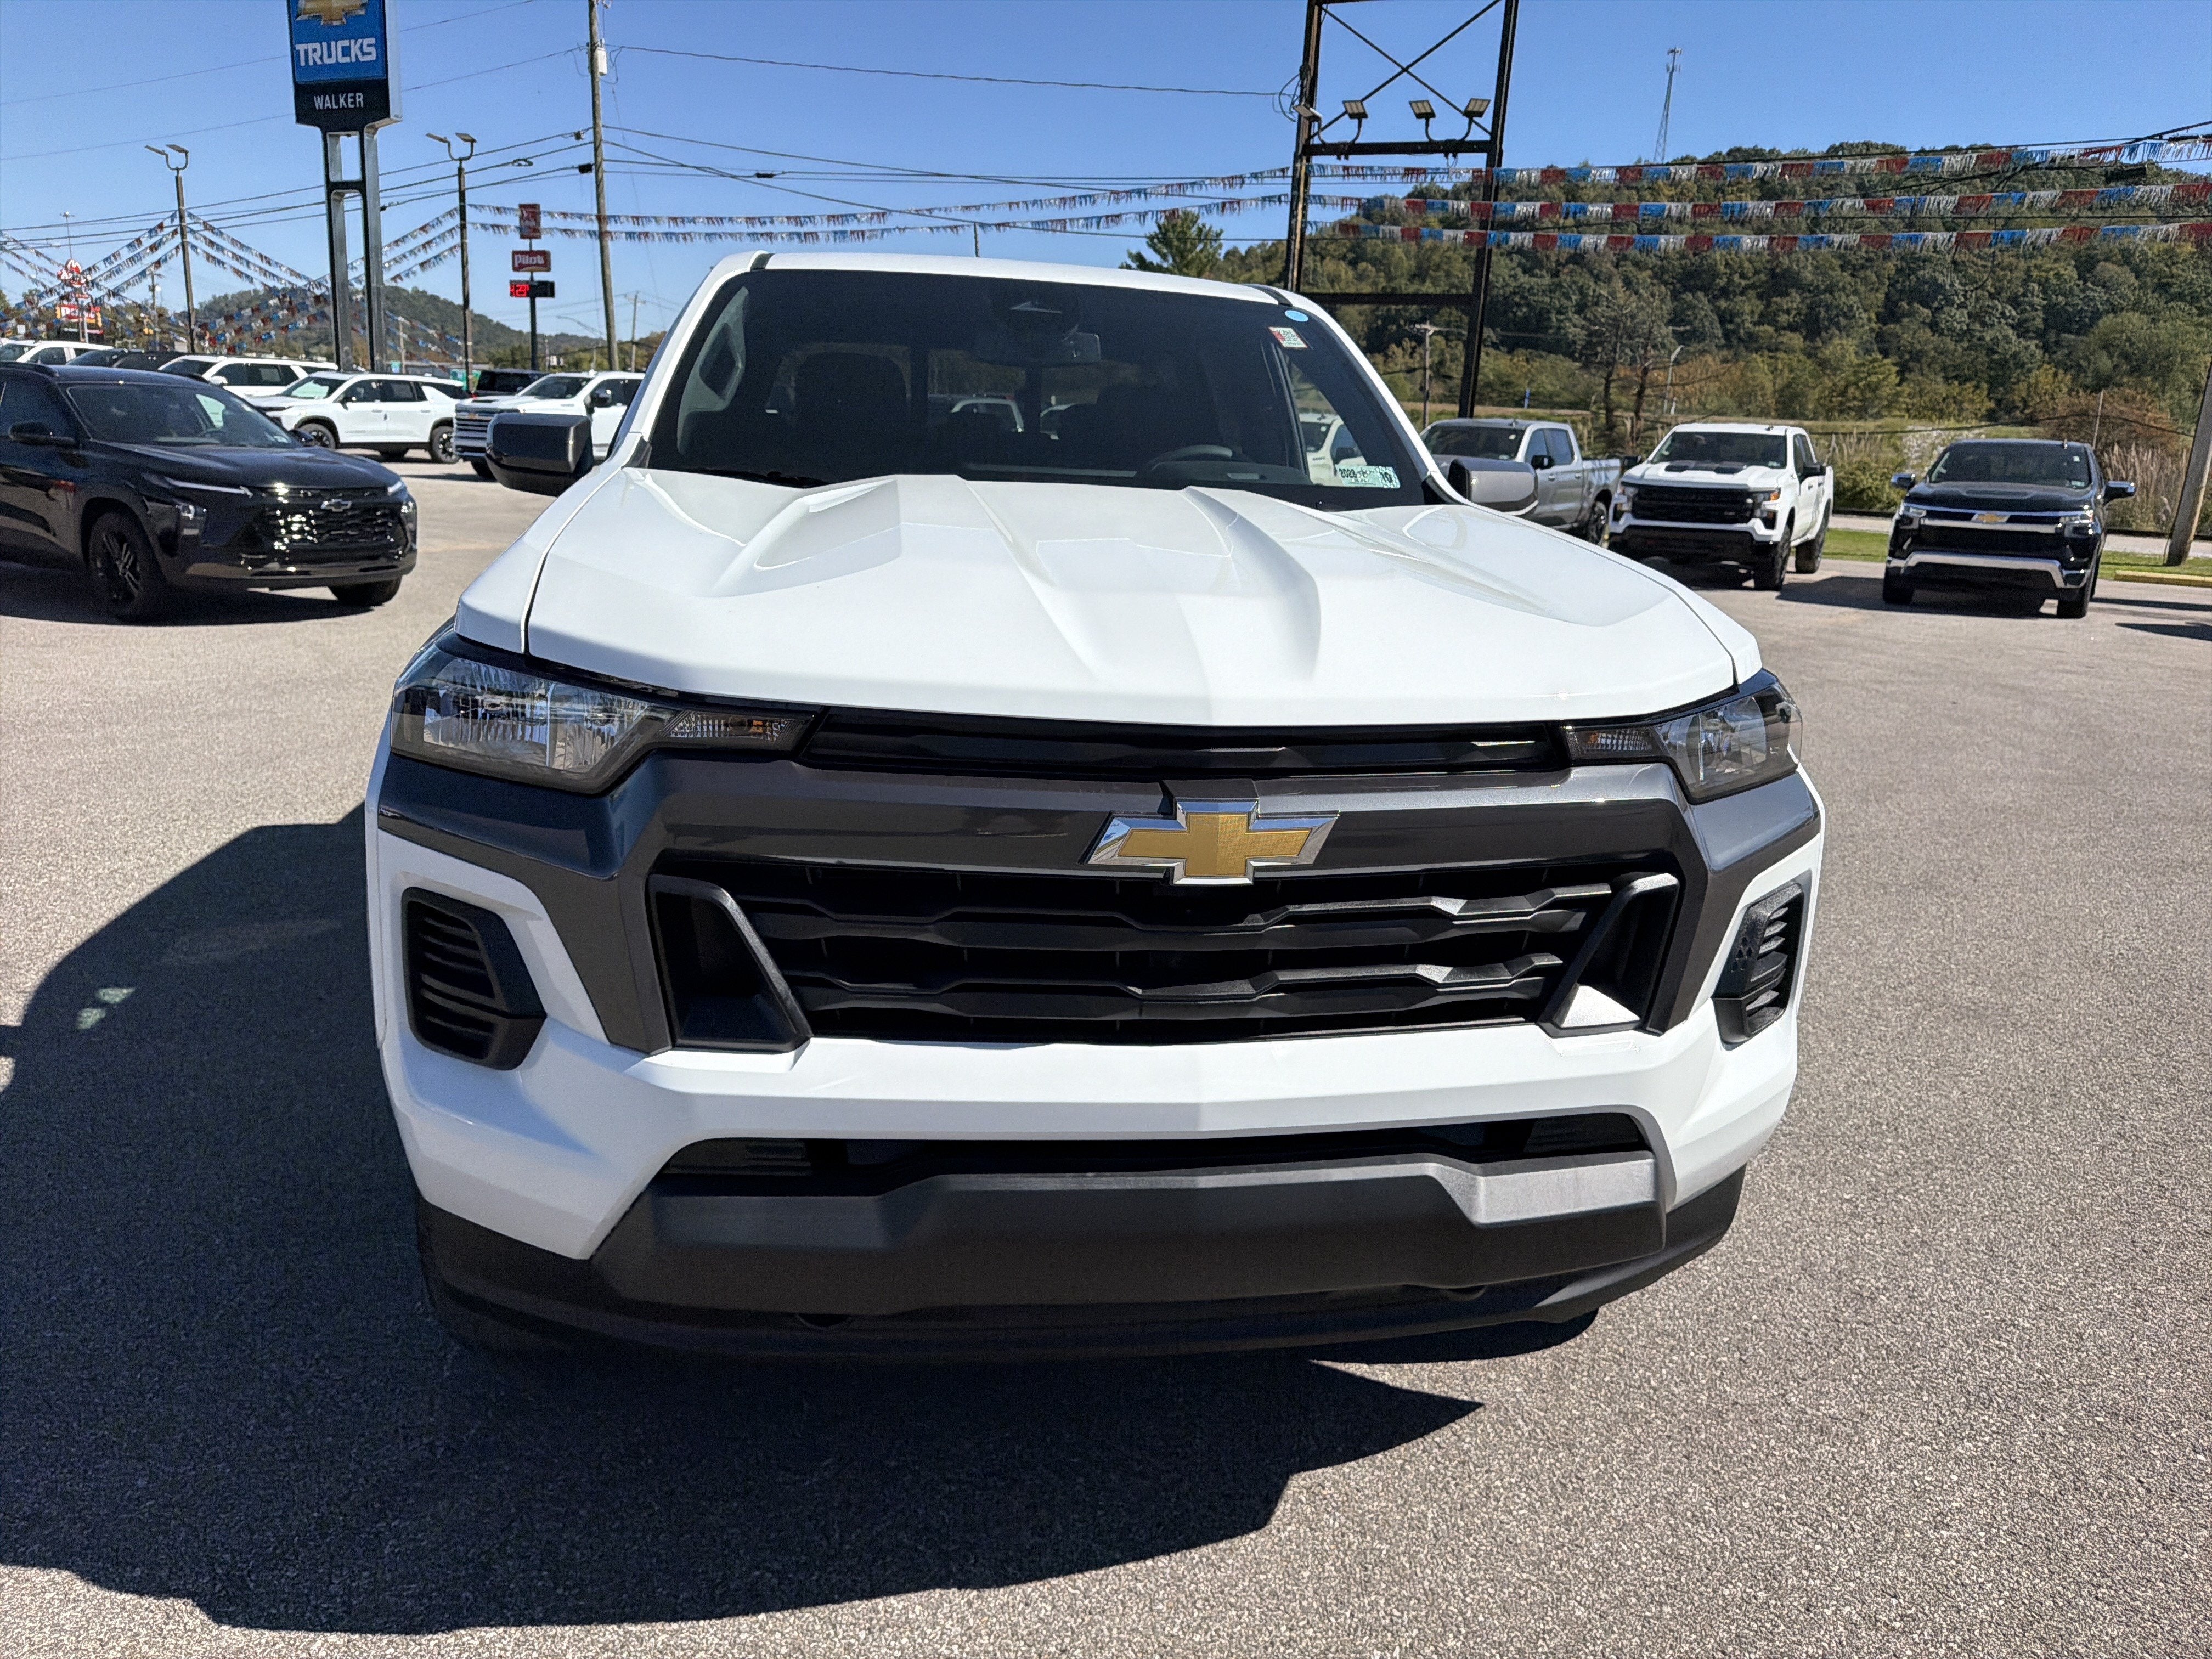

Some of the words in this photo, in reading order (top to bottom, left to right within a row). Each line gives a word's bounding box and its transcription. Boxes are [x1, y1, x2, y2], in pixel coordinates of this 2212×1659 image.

[295, 37, 376, 66] TRUCKS
[314, 92, 364, 110] WALKER
[514, 254, 544, 267] Pilot
[1379, 472, 1393, 483] 10
